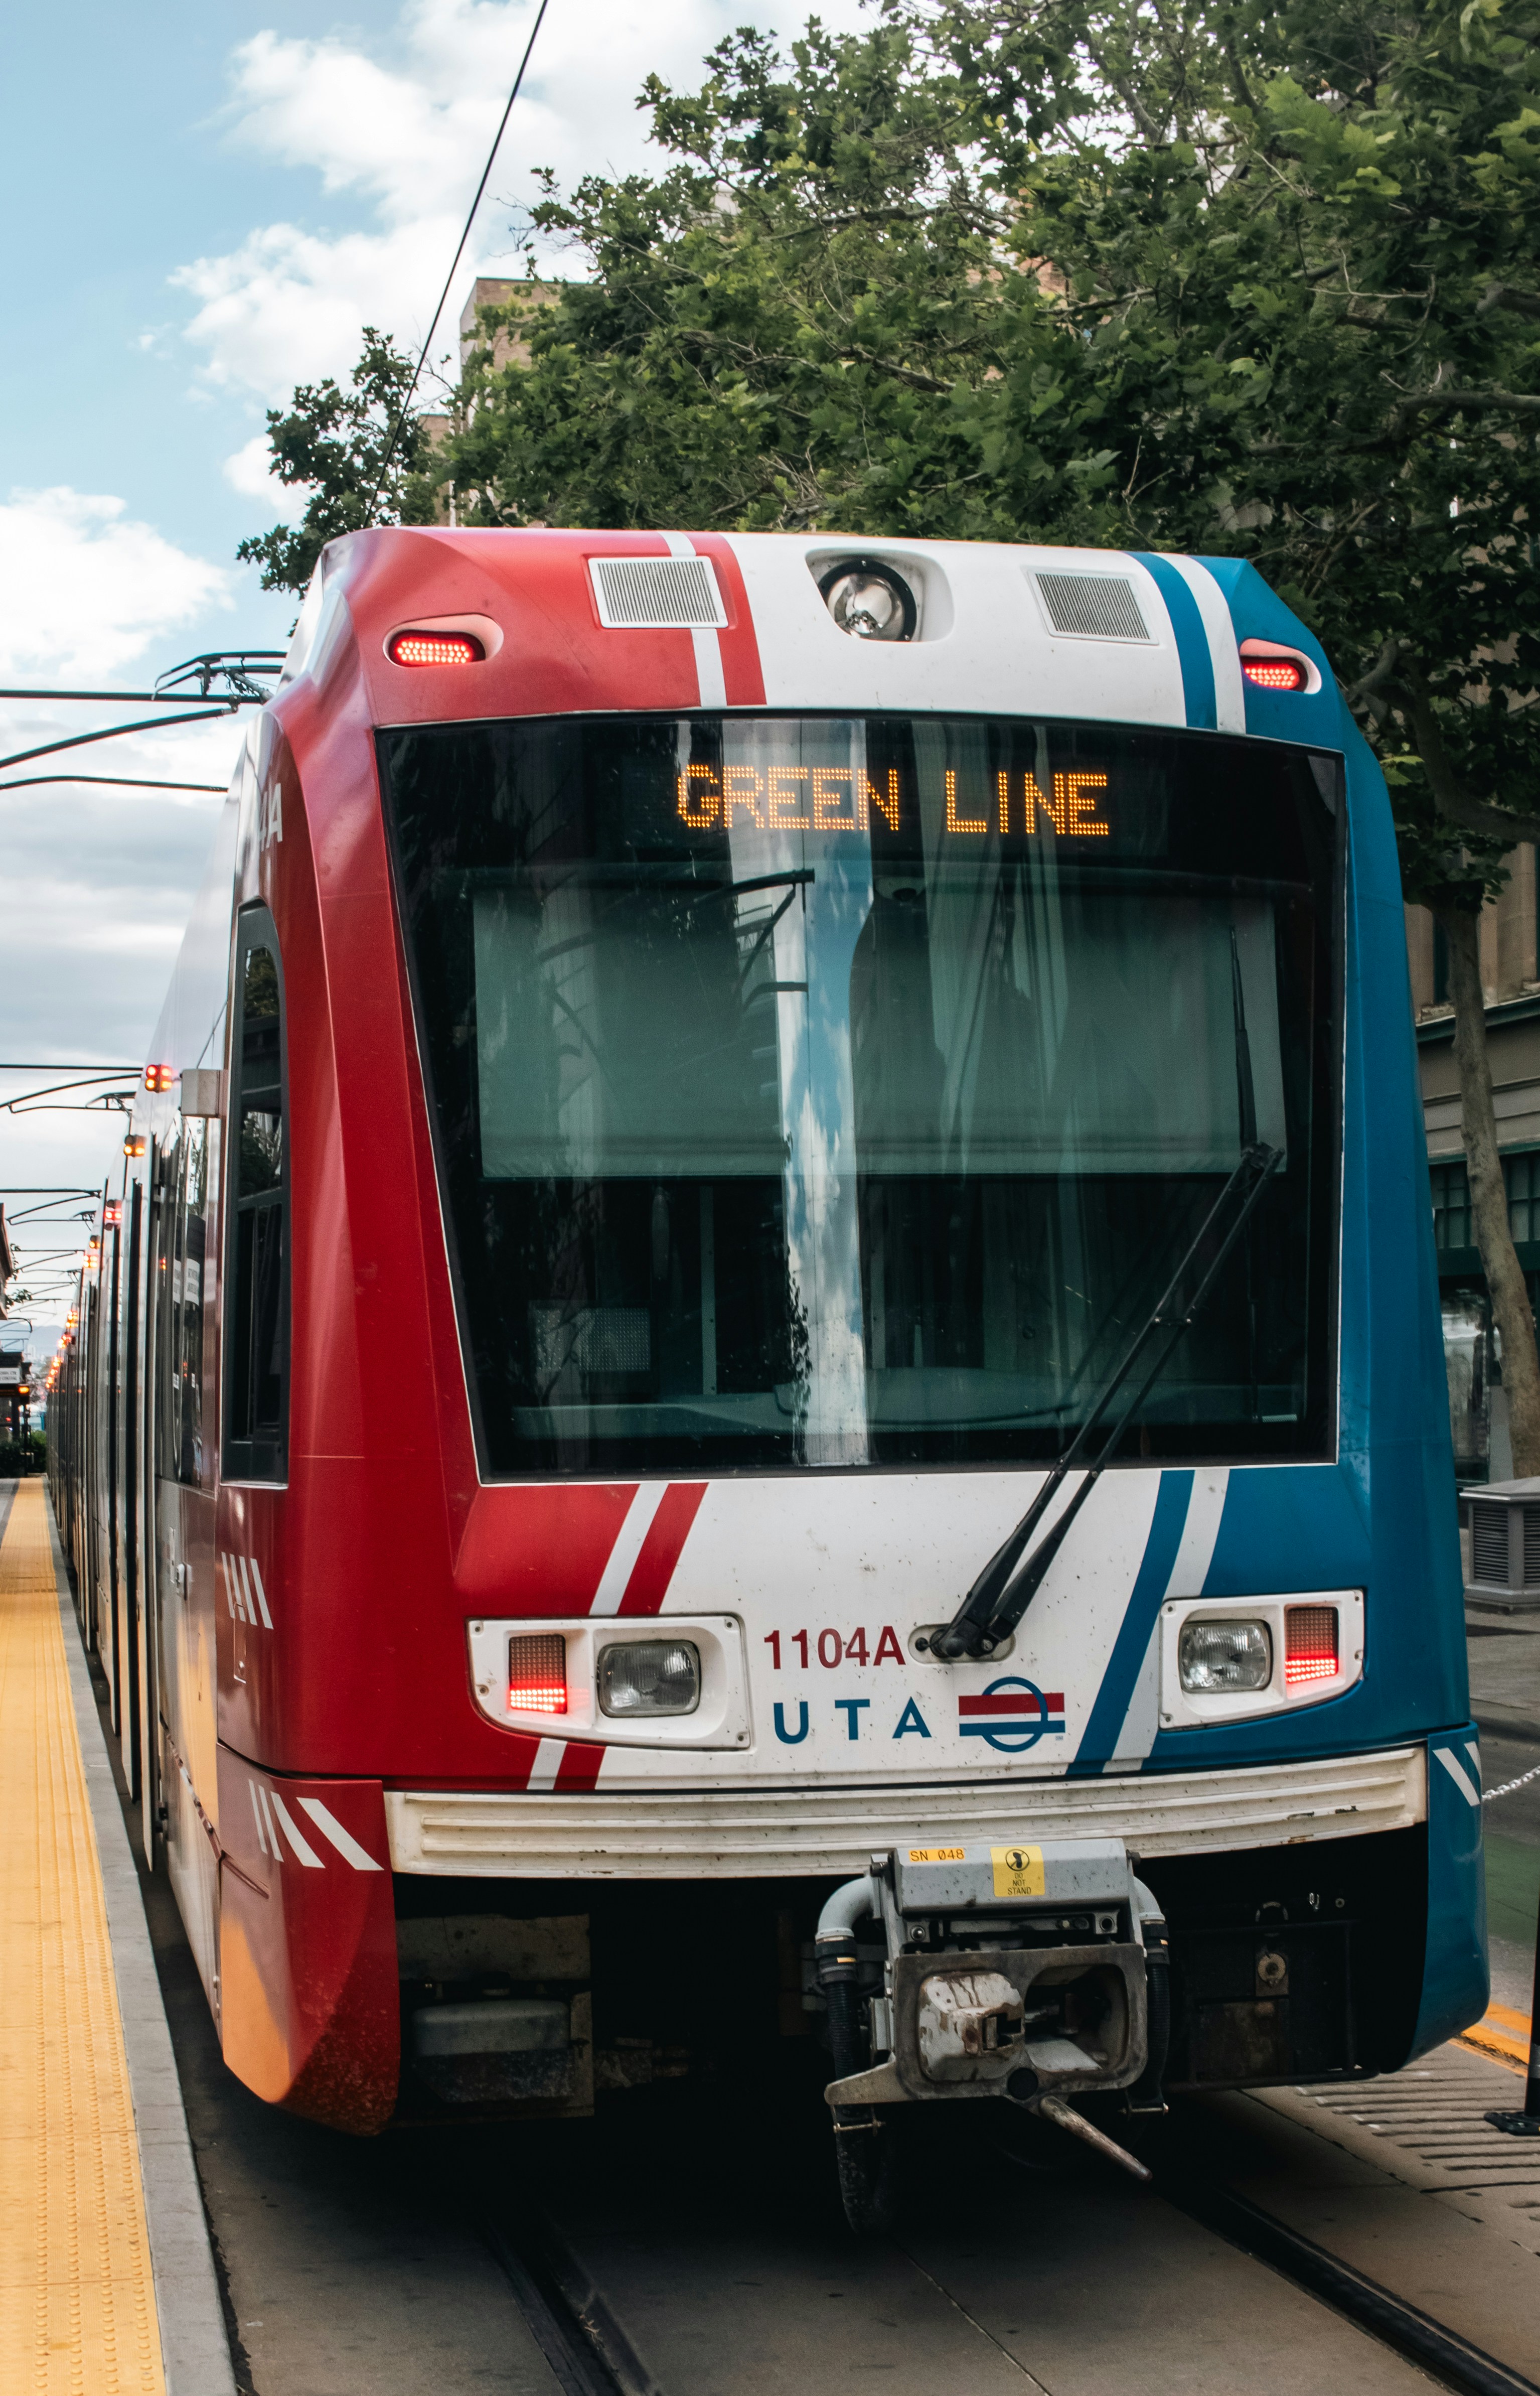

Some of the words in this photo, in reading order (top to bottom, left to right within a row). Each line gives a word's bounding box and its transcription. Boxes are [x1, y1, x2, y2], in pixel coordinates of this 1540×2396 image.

[677, 763, 899, 831] GREEN
[946, 769, 1109, 835] LINE
[763, 1625, 906, 1669] 1104A
[773, 1696, 932, 1744] UTA
[910, 1850, 929, 1862] SN
[938, 1849, 964, 1860] 048
[1007, 1887, 1032, 1895] STAND
